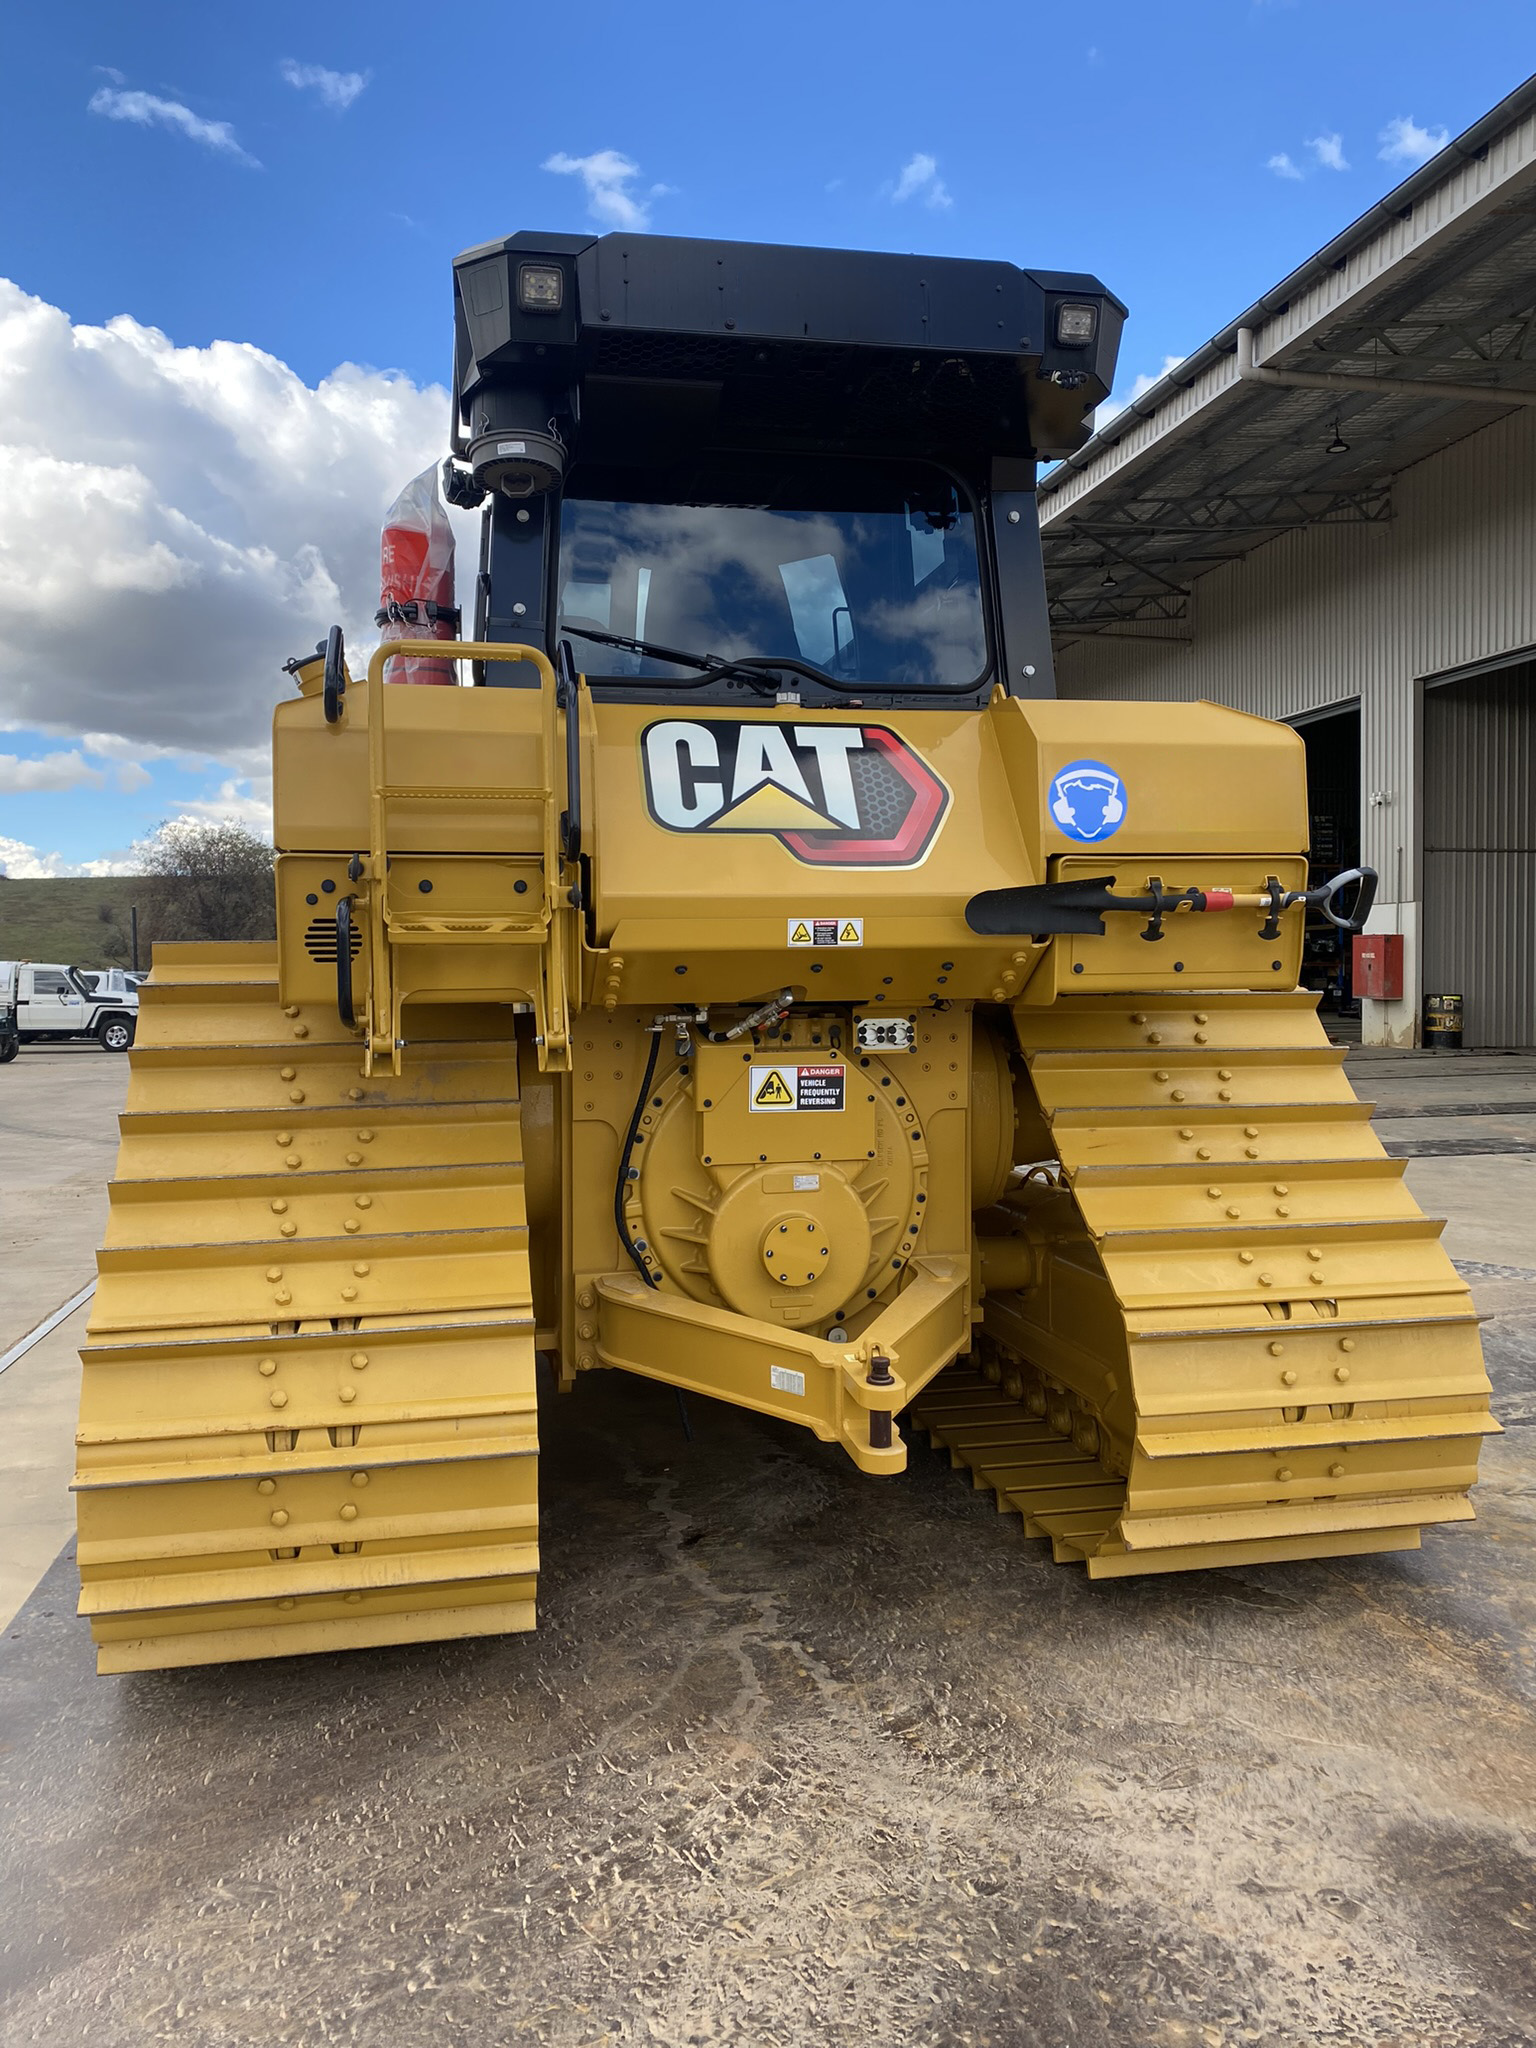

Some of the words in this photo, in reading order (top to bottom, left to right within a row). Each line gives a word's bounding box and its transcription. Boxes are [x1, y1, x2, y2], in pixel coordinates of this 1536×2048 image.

[646, 721, 864, 830] CAT
[810, 1068, 841, 1076] DANGER
[800, 1079, 826, 1087] VEHICLE
[800, 1088, 841, 1097] FREQUENTLY
[800, 1097, 836, 1105] REVERSING
